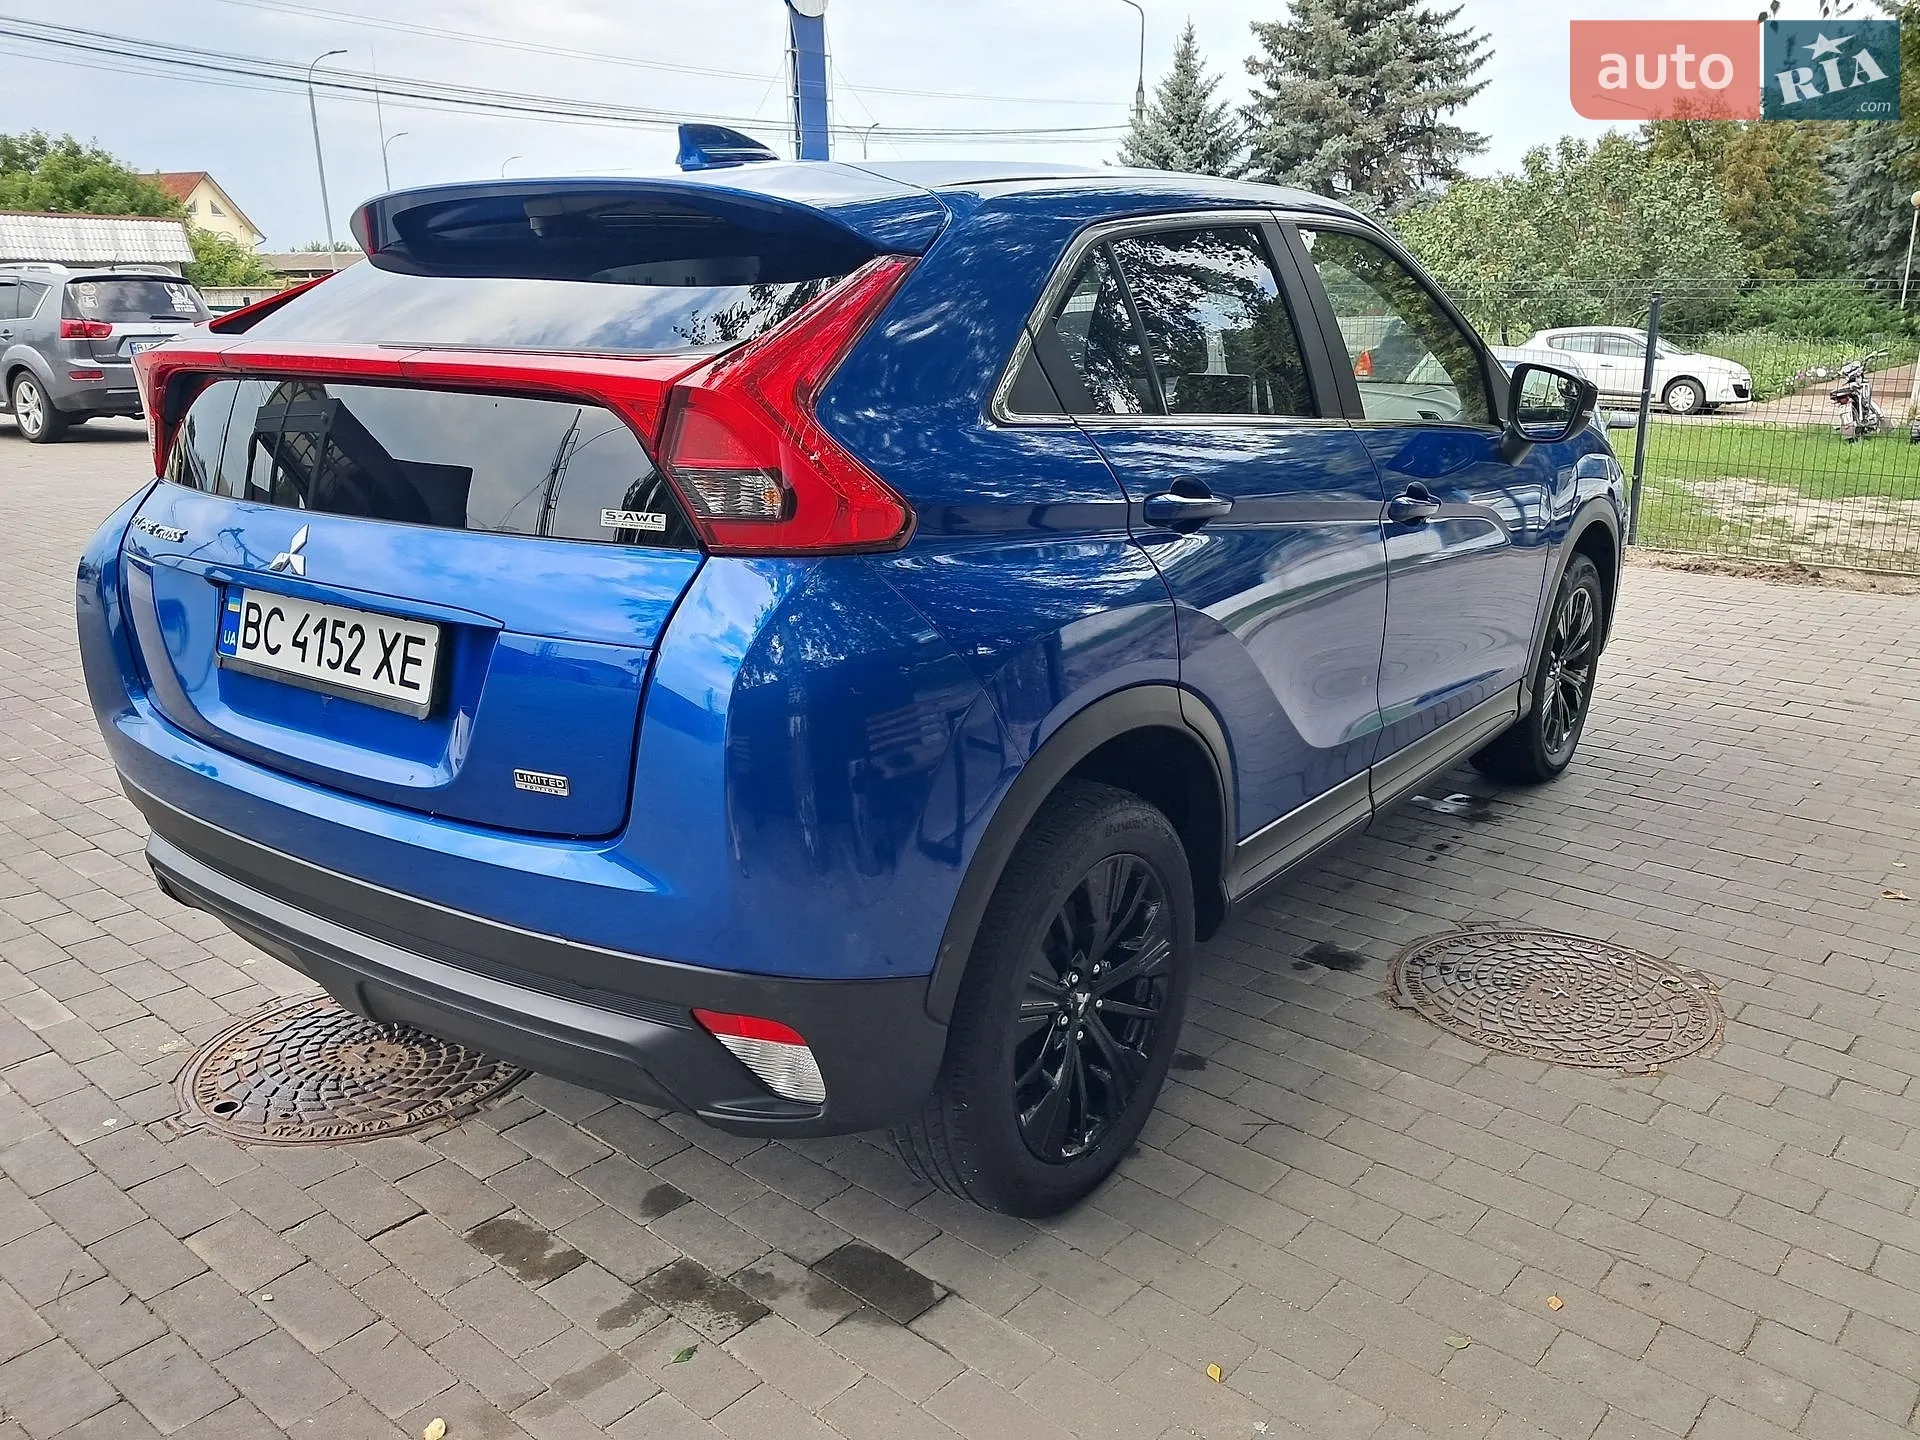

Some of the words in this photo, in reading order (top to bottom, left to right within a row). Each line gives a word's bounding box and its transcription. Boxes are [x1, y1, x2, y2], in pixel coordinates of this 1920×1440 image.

[605, 511, 662, 523] S-AWC
[224, 630, 236, 646] UA
[242, 603, 285, 655] BC
[292, 613, 366, 675] 4152
[372, 628, 426, 690] XE
[516, 773, 565, 788] LIMITED
